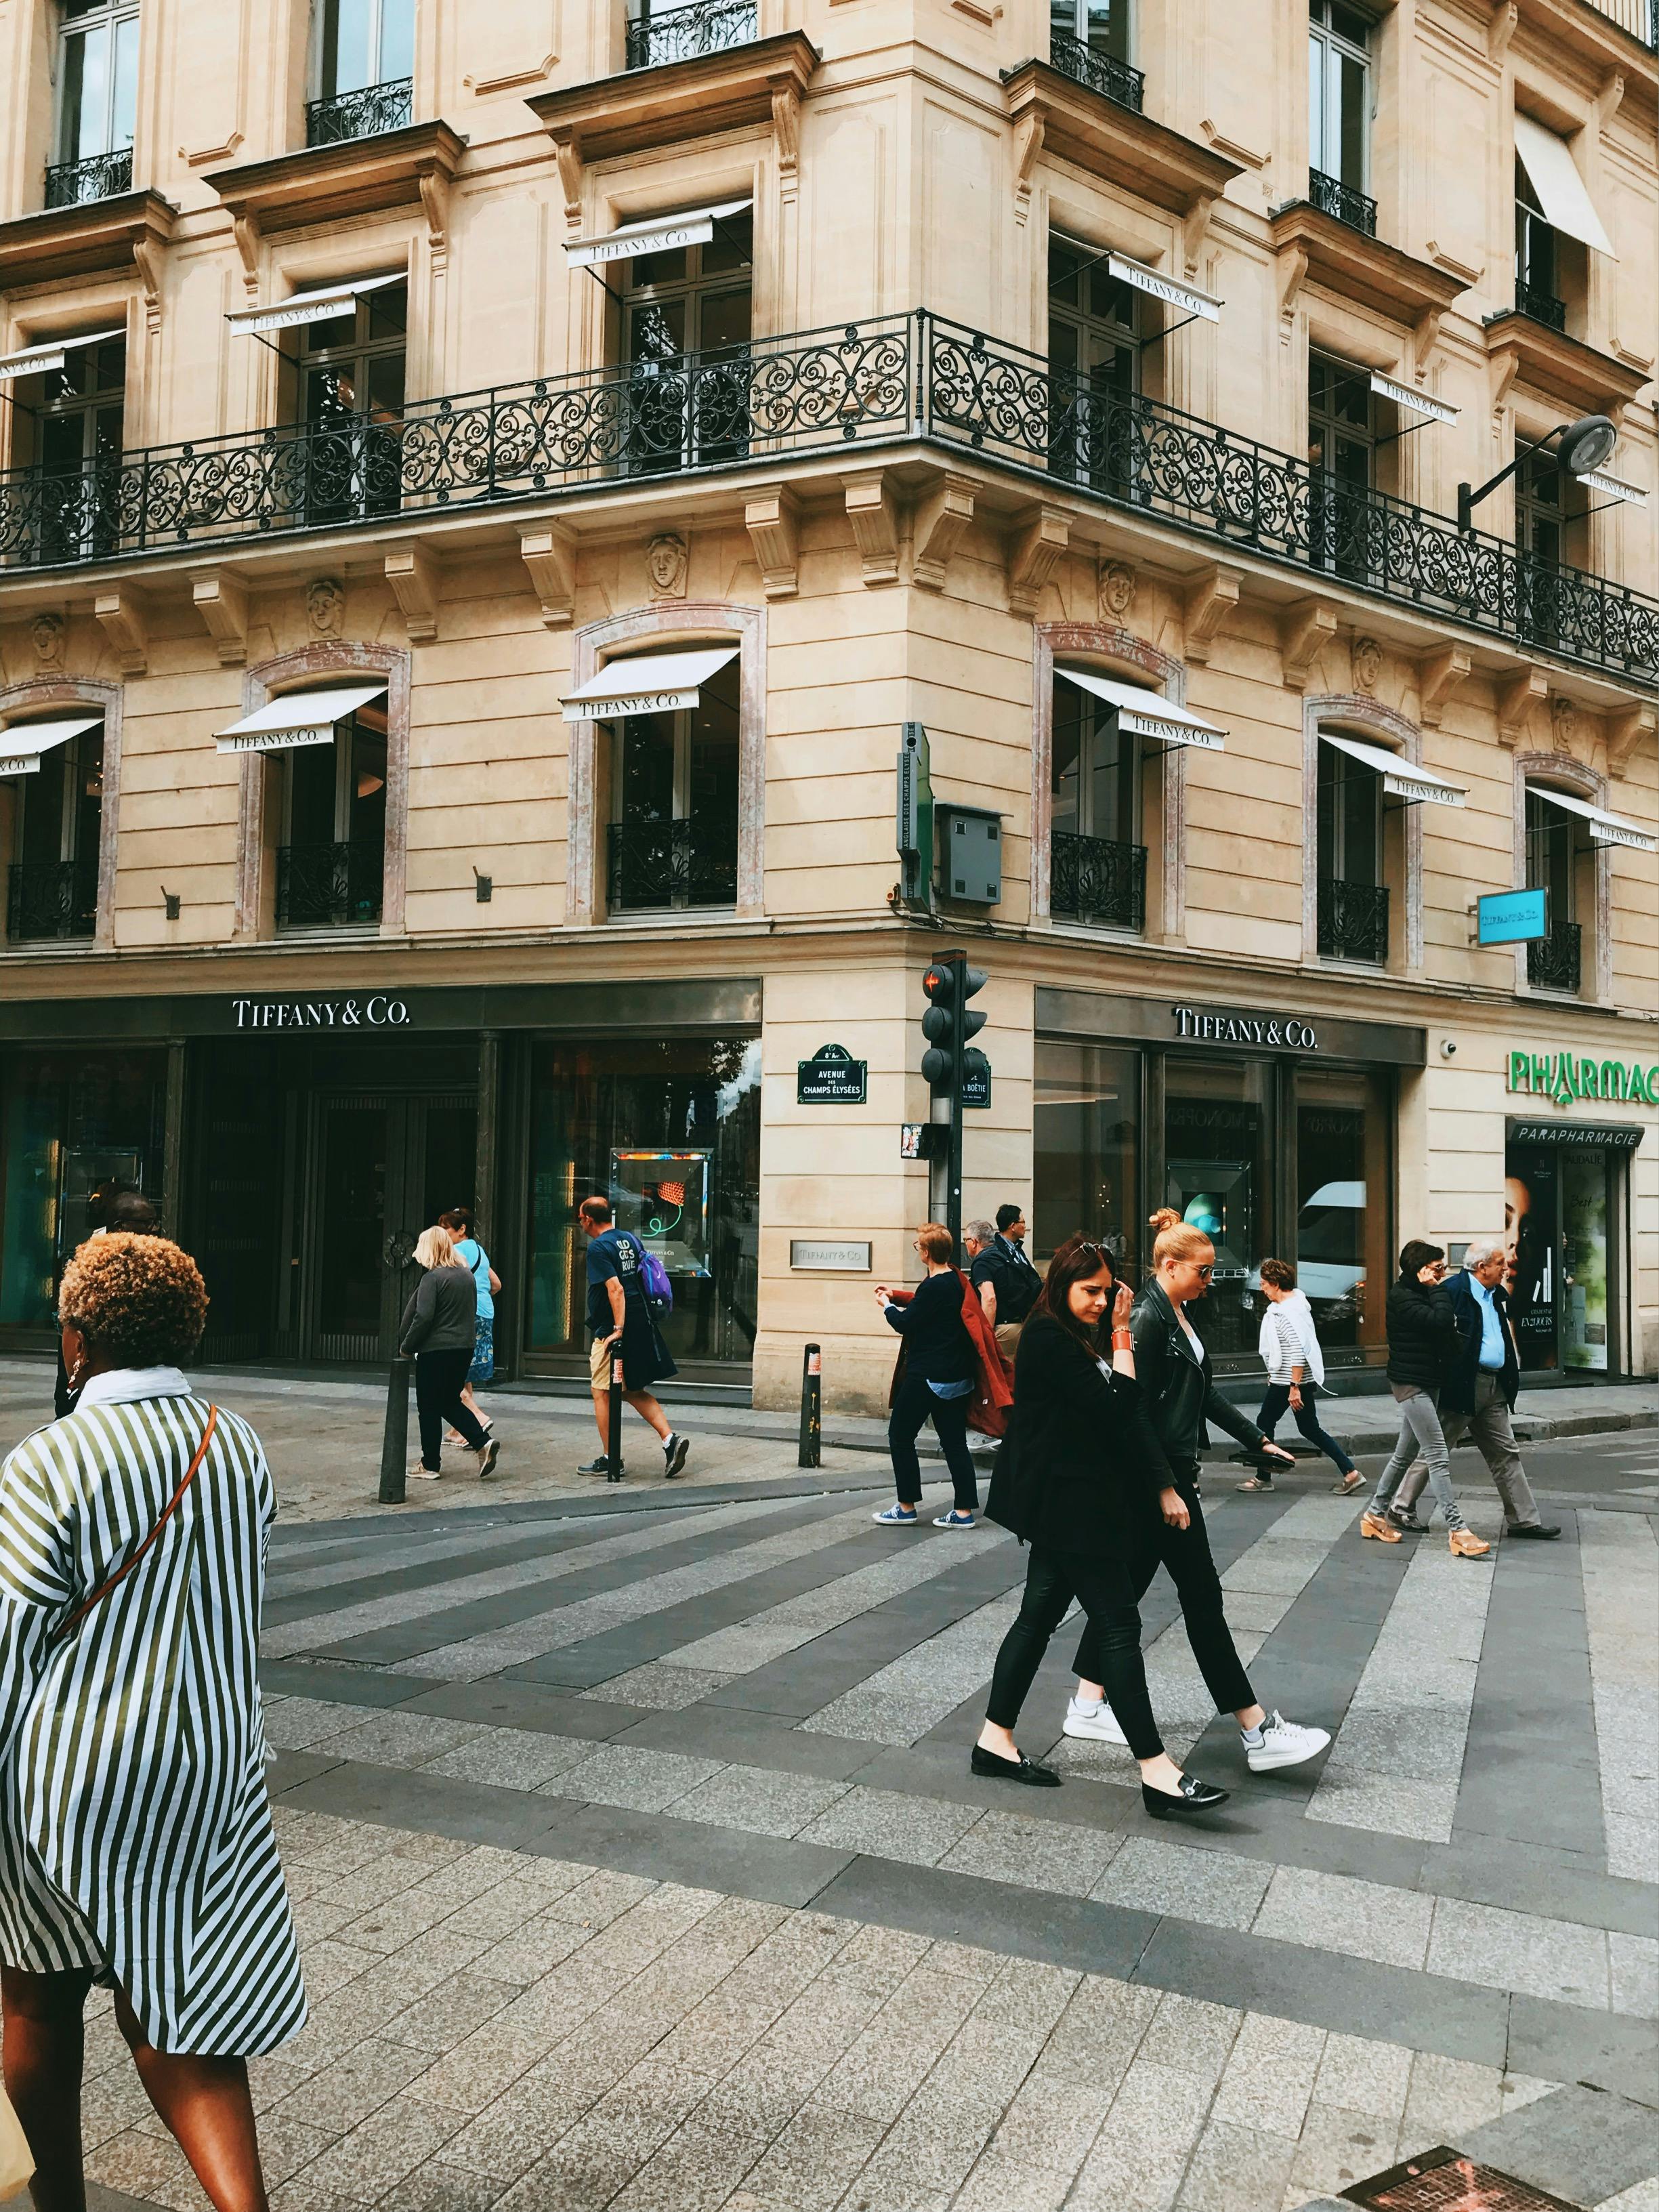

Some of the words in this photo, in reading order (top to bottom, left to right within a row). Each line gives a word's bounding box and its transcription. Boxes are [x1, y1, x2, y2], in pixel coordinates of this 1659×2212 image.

[818, 1070, 845, 1079] AVENUE
[832, 1084, 860, 1093] ÉLYSÉES
[1519, 1127, 1637, 1145] PARAPHARMACIE
